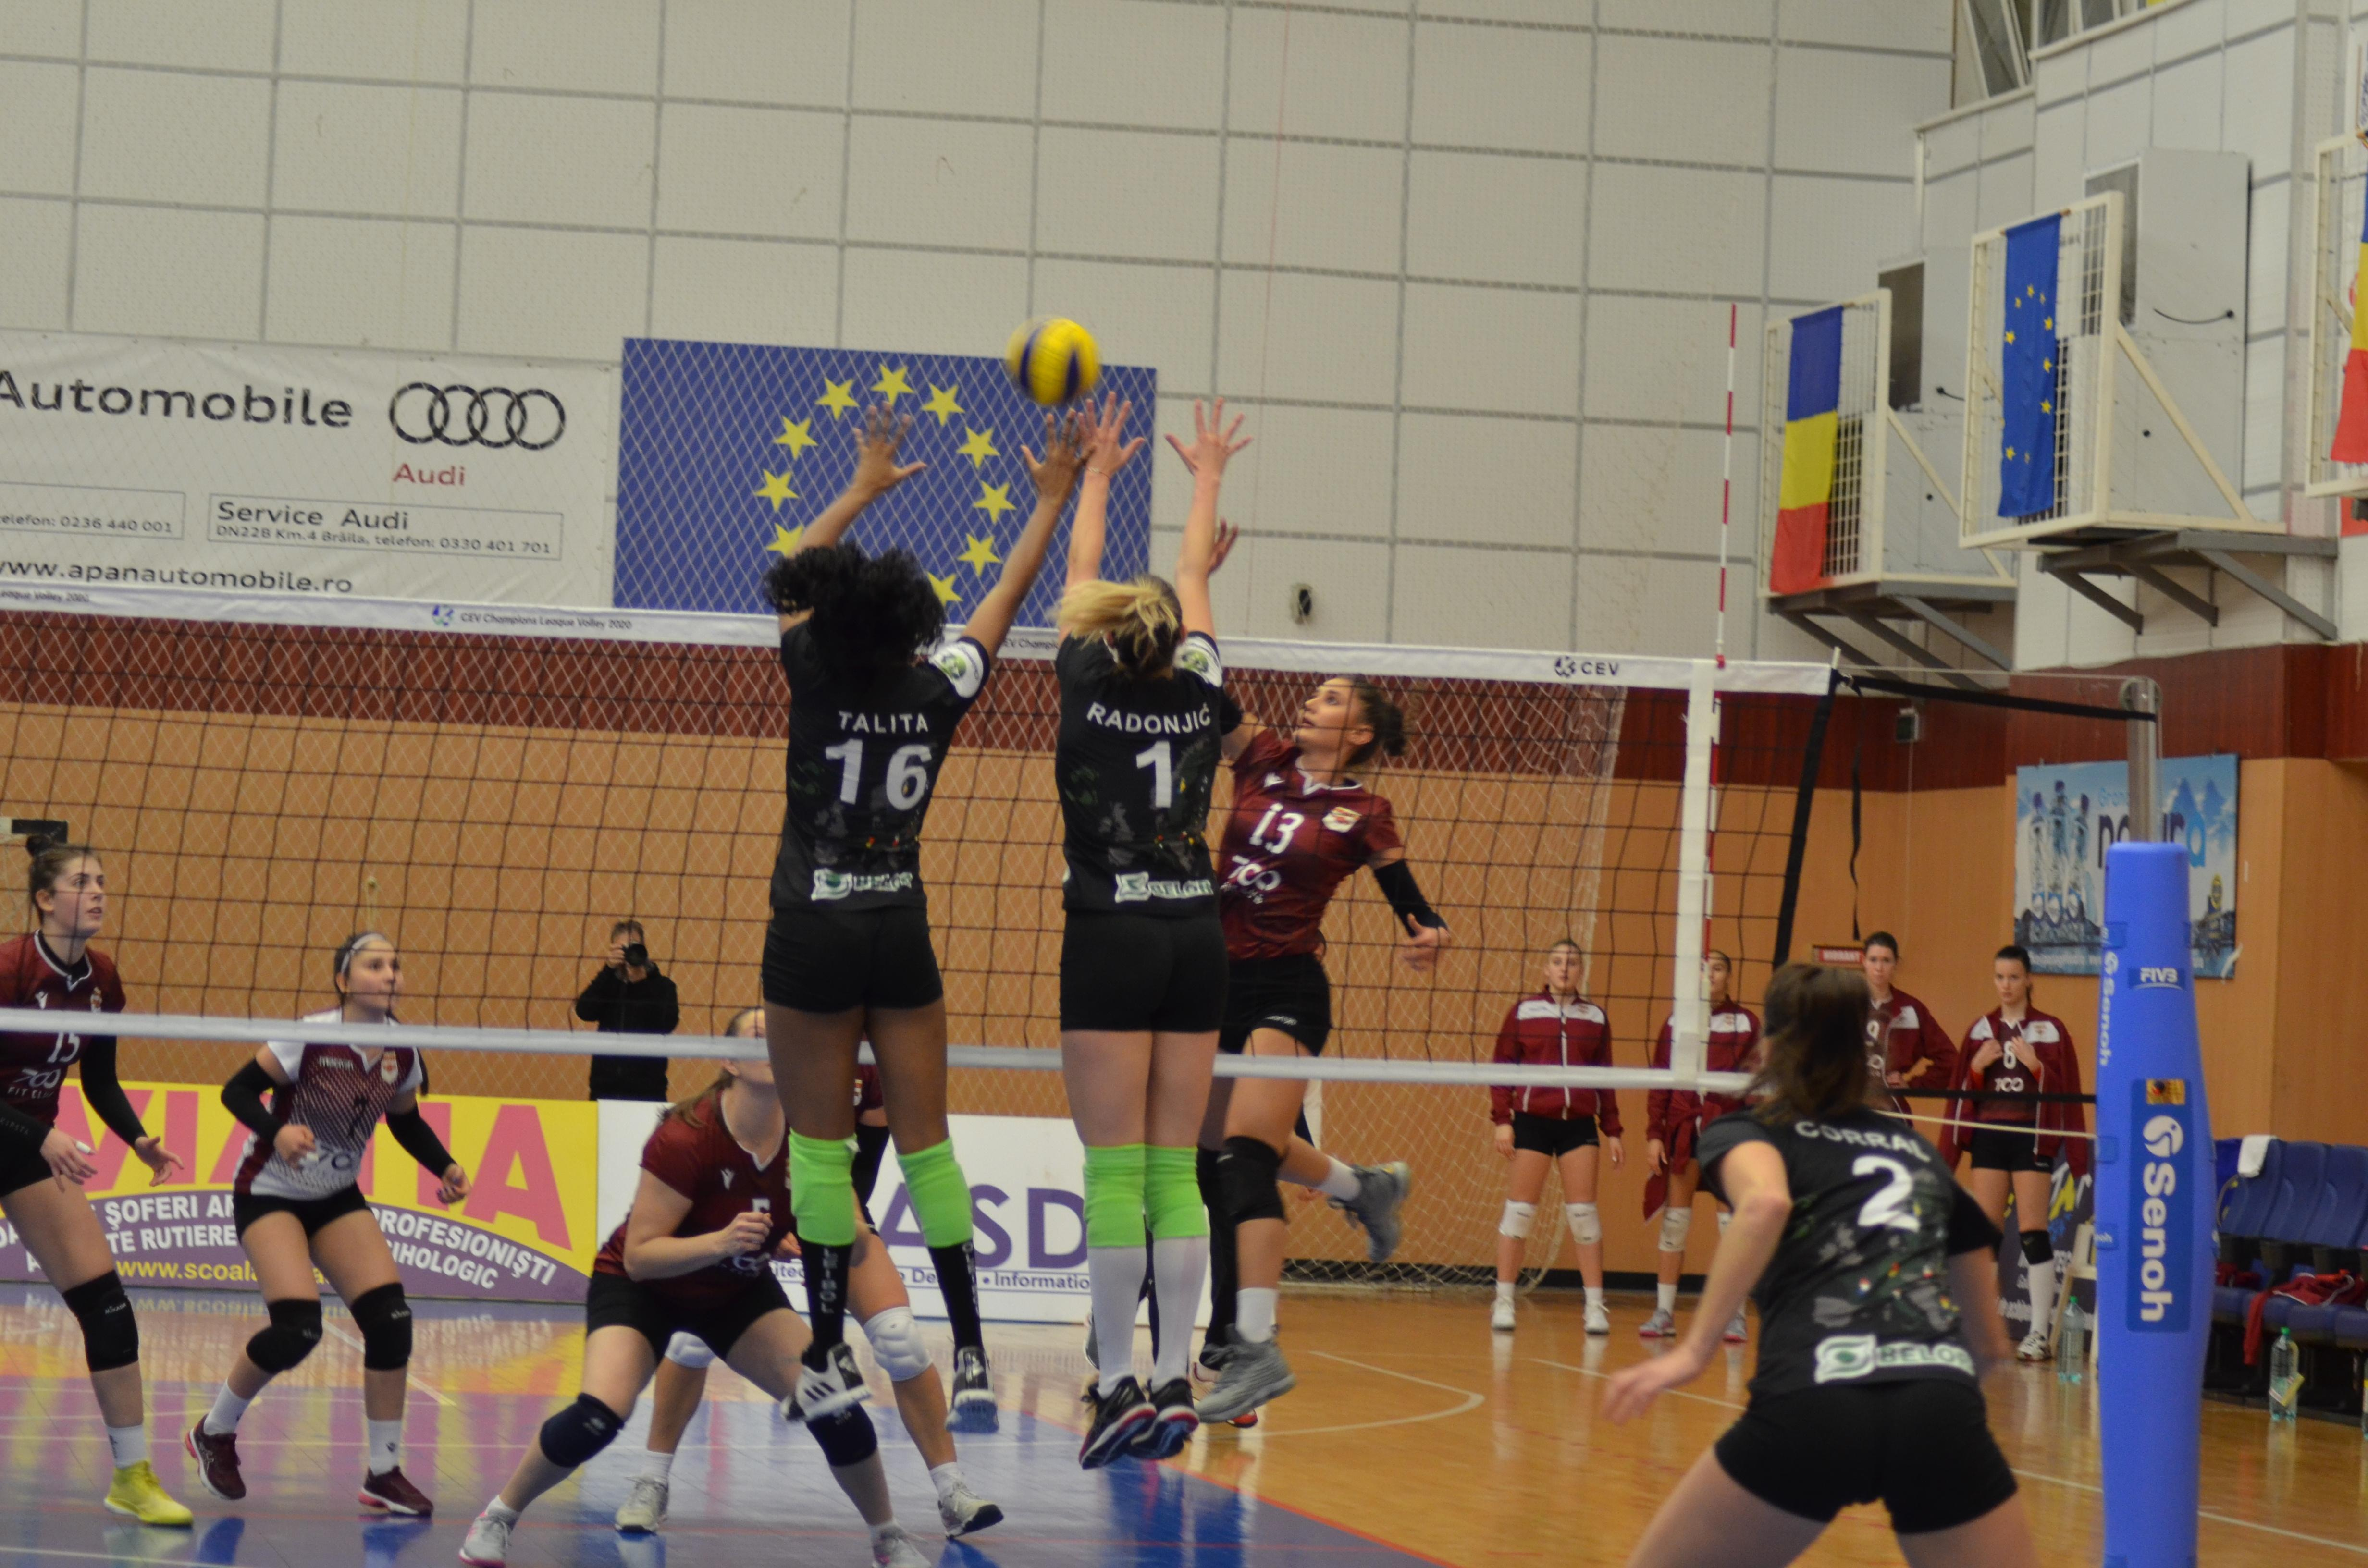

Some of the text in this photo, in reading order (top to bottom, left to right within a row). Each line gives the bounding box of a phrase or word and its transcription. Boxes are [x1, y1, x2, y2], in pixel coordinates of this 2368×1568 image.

[0, 369, 352, 428] Automobile
[393, 463, 466, 486] Audi
[0, 514, 56, 527] elefon:
[60, 516, 102, 528] 0236
[107, 519, 138, 531] 440
[218, 501, 408, 530] Service Audi
[440, 537, 481, 550] 0330
[487, 540, 515, 552] 401
[521, 541, 550, 554] 701
[0, 561, 352, 593] ww.apanautomobile.ro
[1581, 662, 1620, 676] CEV
[838, 710, 929, 734] TALITA
[825, 738, 932, 811] 16
[1135, 740, 1172, 809] 1
[1249, 803, 1304, 854] 13
[1794, 1120, 1931, 1163] CORRAL
[1852, 1155, 1920, 1233] 2
[139, 1225, 237, 1251] RUTIERE
[386, 1240, 499, 1290] IHOLOGIC
